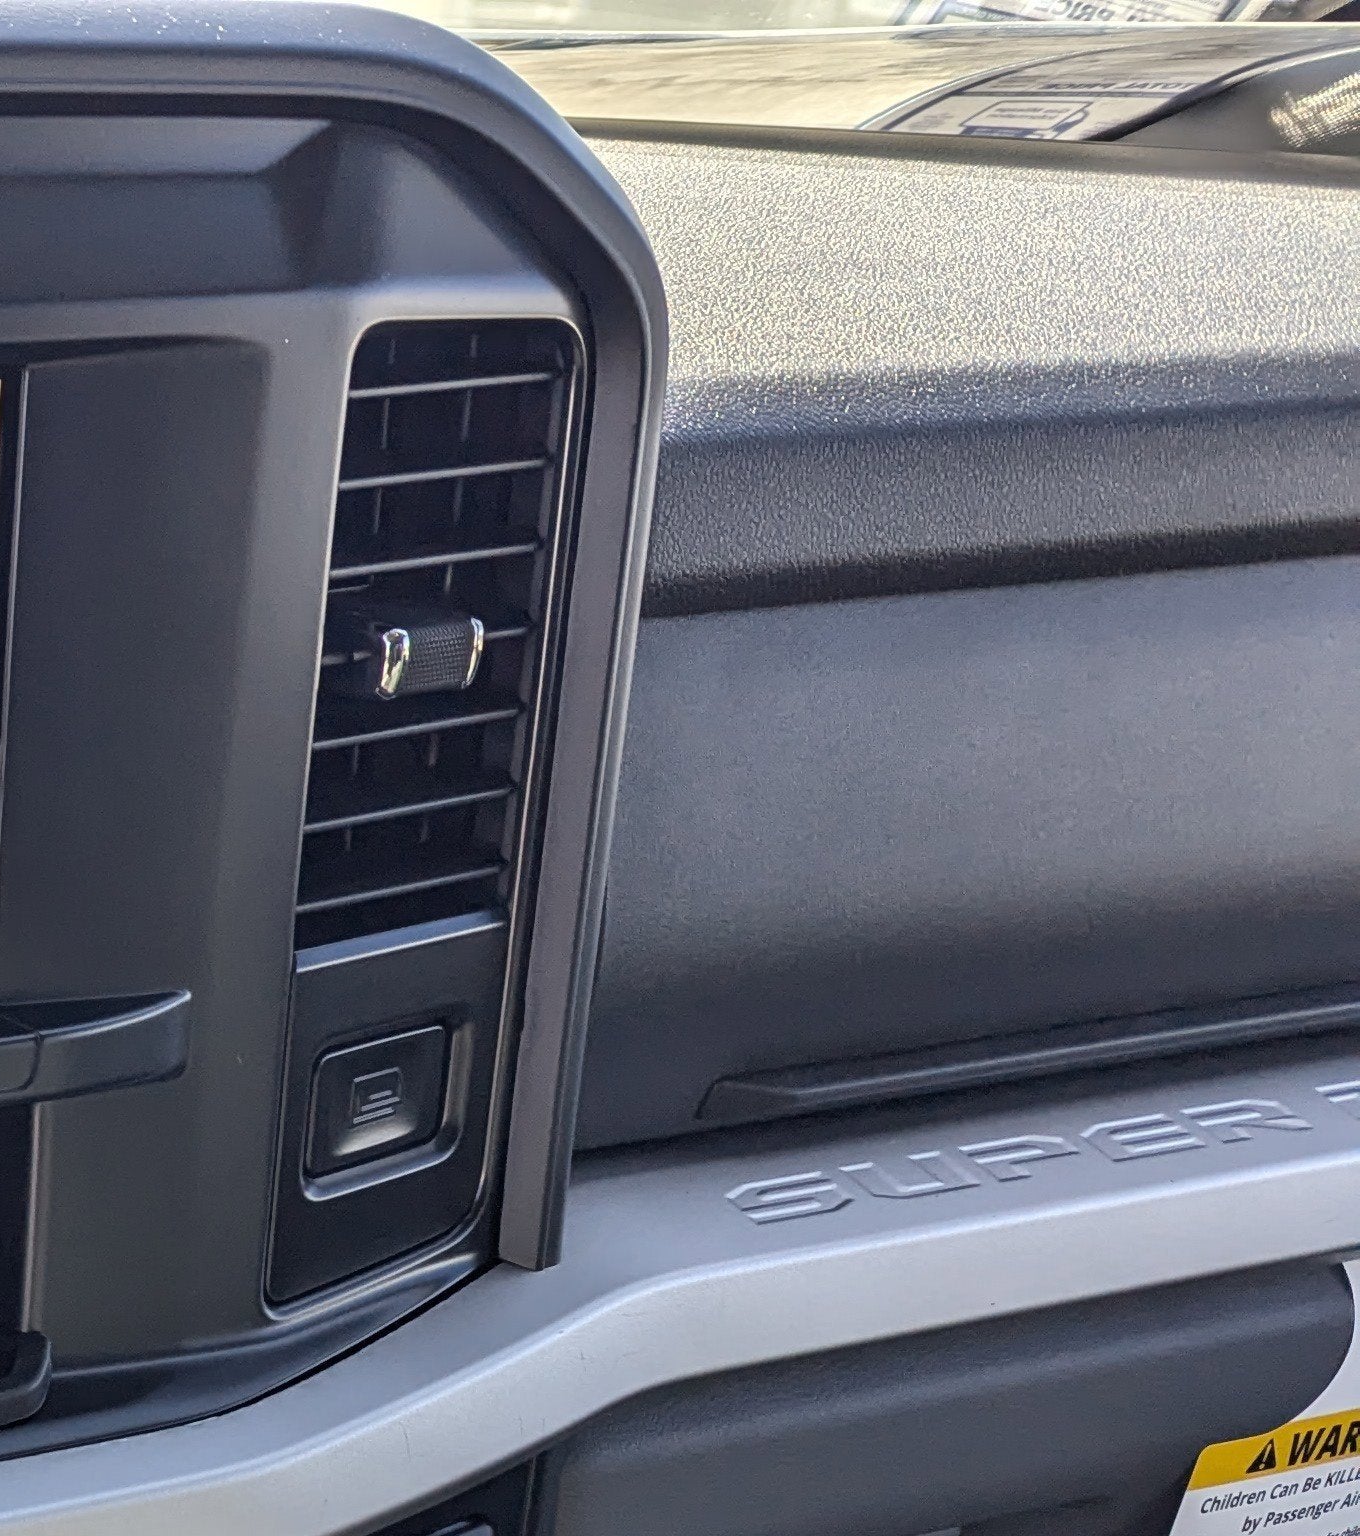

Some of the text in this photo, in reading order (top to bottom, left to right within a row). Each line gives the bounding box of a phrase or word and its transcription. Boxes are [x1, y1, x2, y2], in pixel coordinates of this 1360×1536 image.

[722, 1096, 1314, 1227] SUPER
[1199, 1488, 1267, 1515] Children
[1269, 1482, 1299, 1500] Can
[1301, 1475, 1322, 1493] Be
[1241, 1514, 1262, 1535] by
[1263, 1498, 1340, 1528] Passenger
